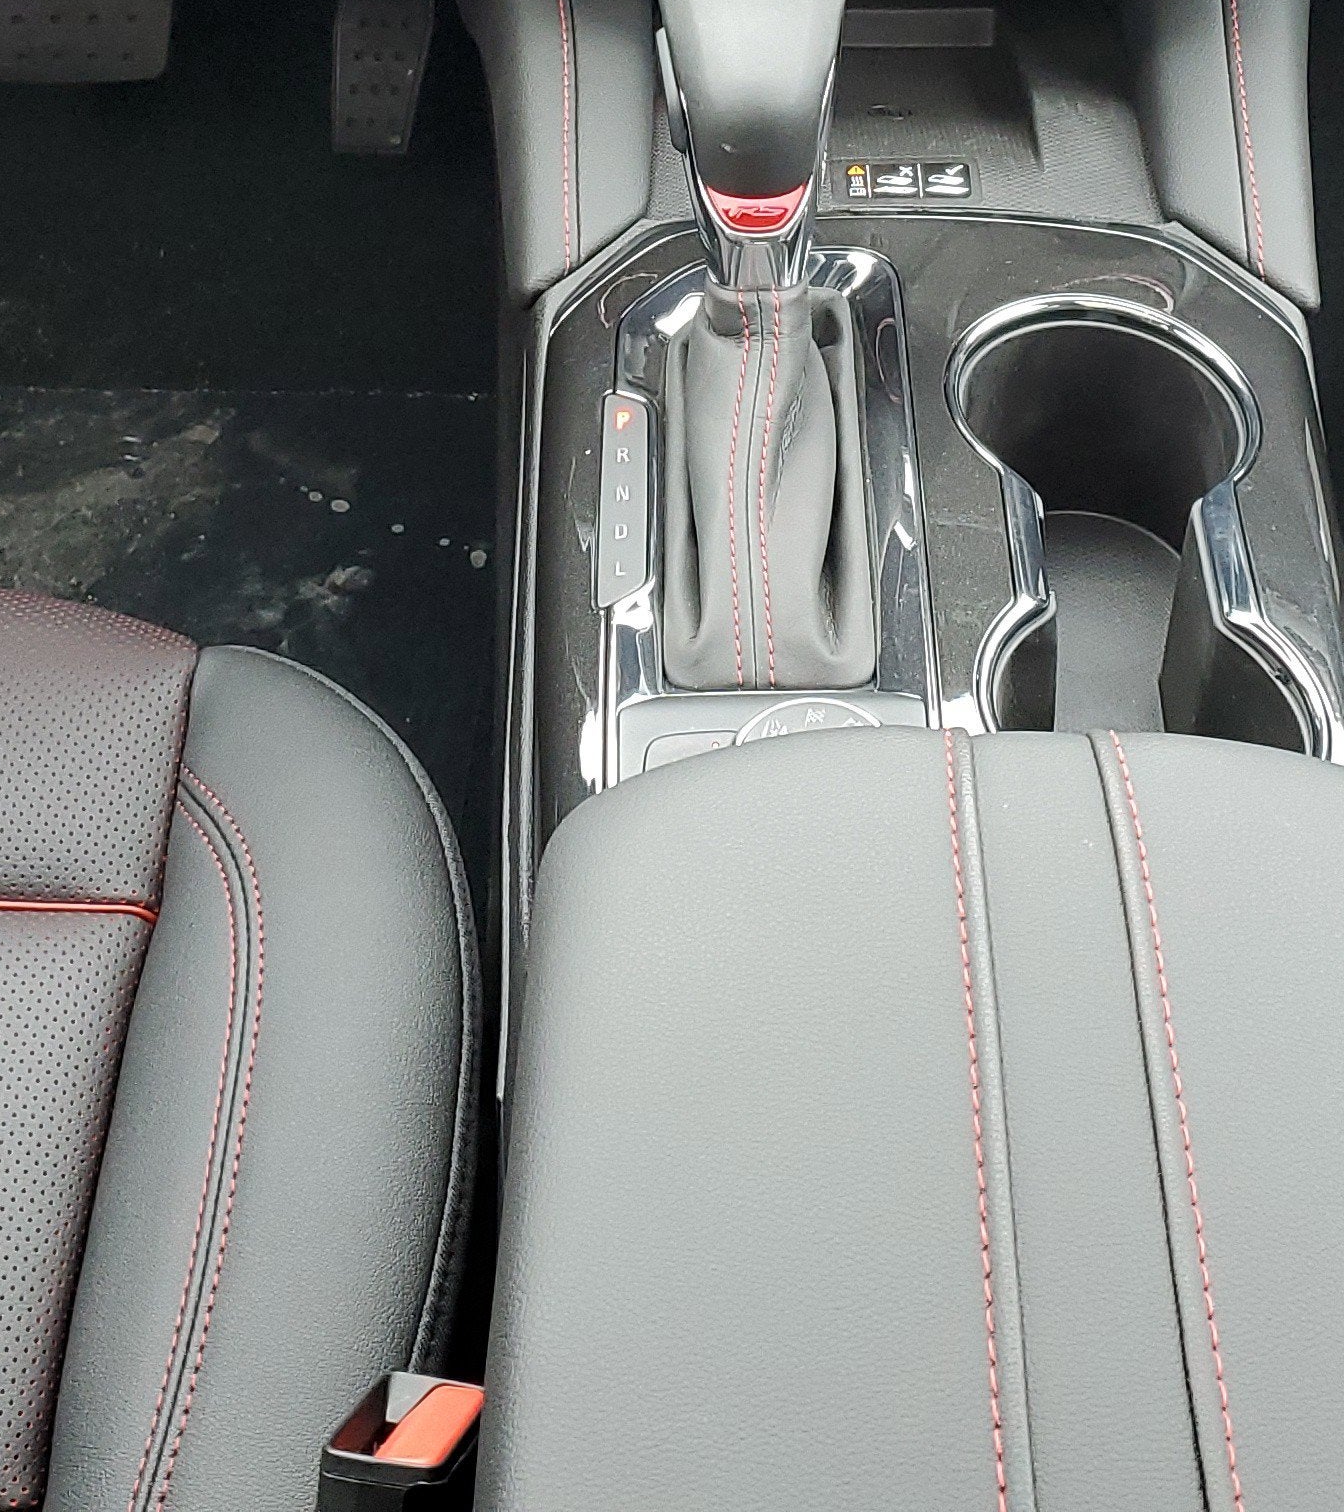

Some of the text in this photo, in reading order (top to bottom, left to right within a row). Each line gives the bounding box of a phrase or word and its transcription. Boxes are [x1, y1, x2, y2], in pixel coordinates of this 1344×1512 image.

[616, 411, 630, 429] P
[616, 447, 630, 463] R
[616, 485, 630, 502] N
[614, 523, 628, 540] D
[614, 560, 626, 577] L
